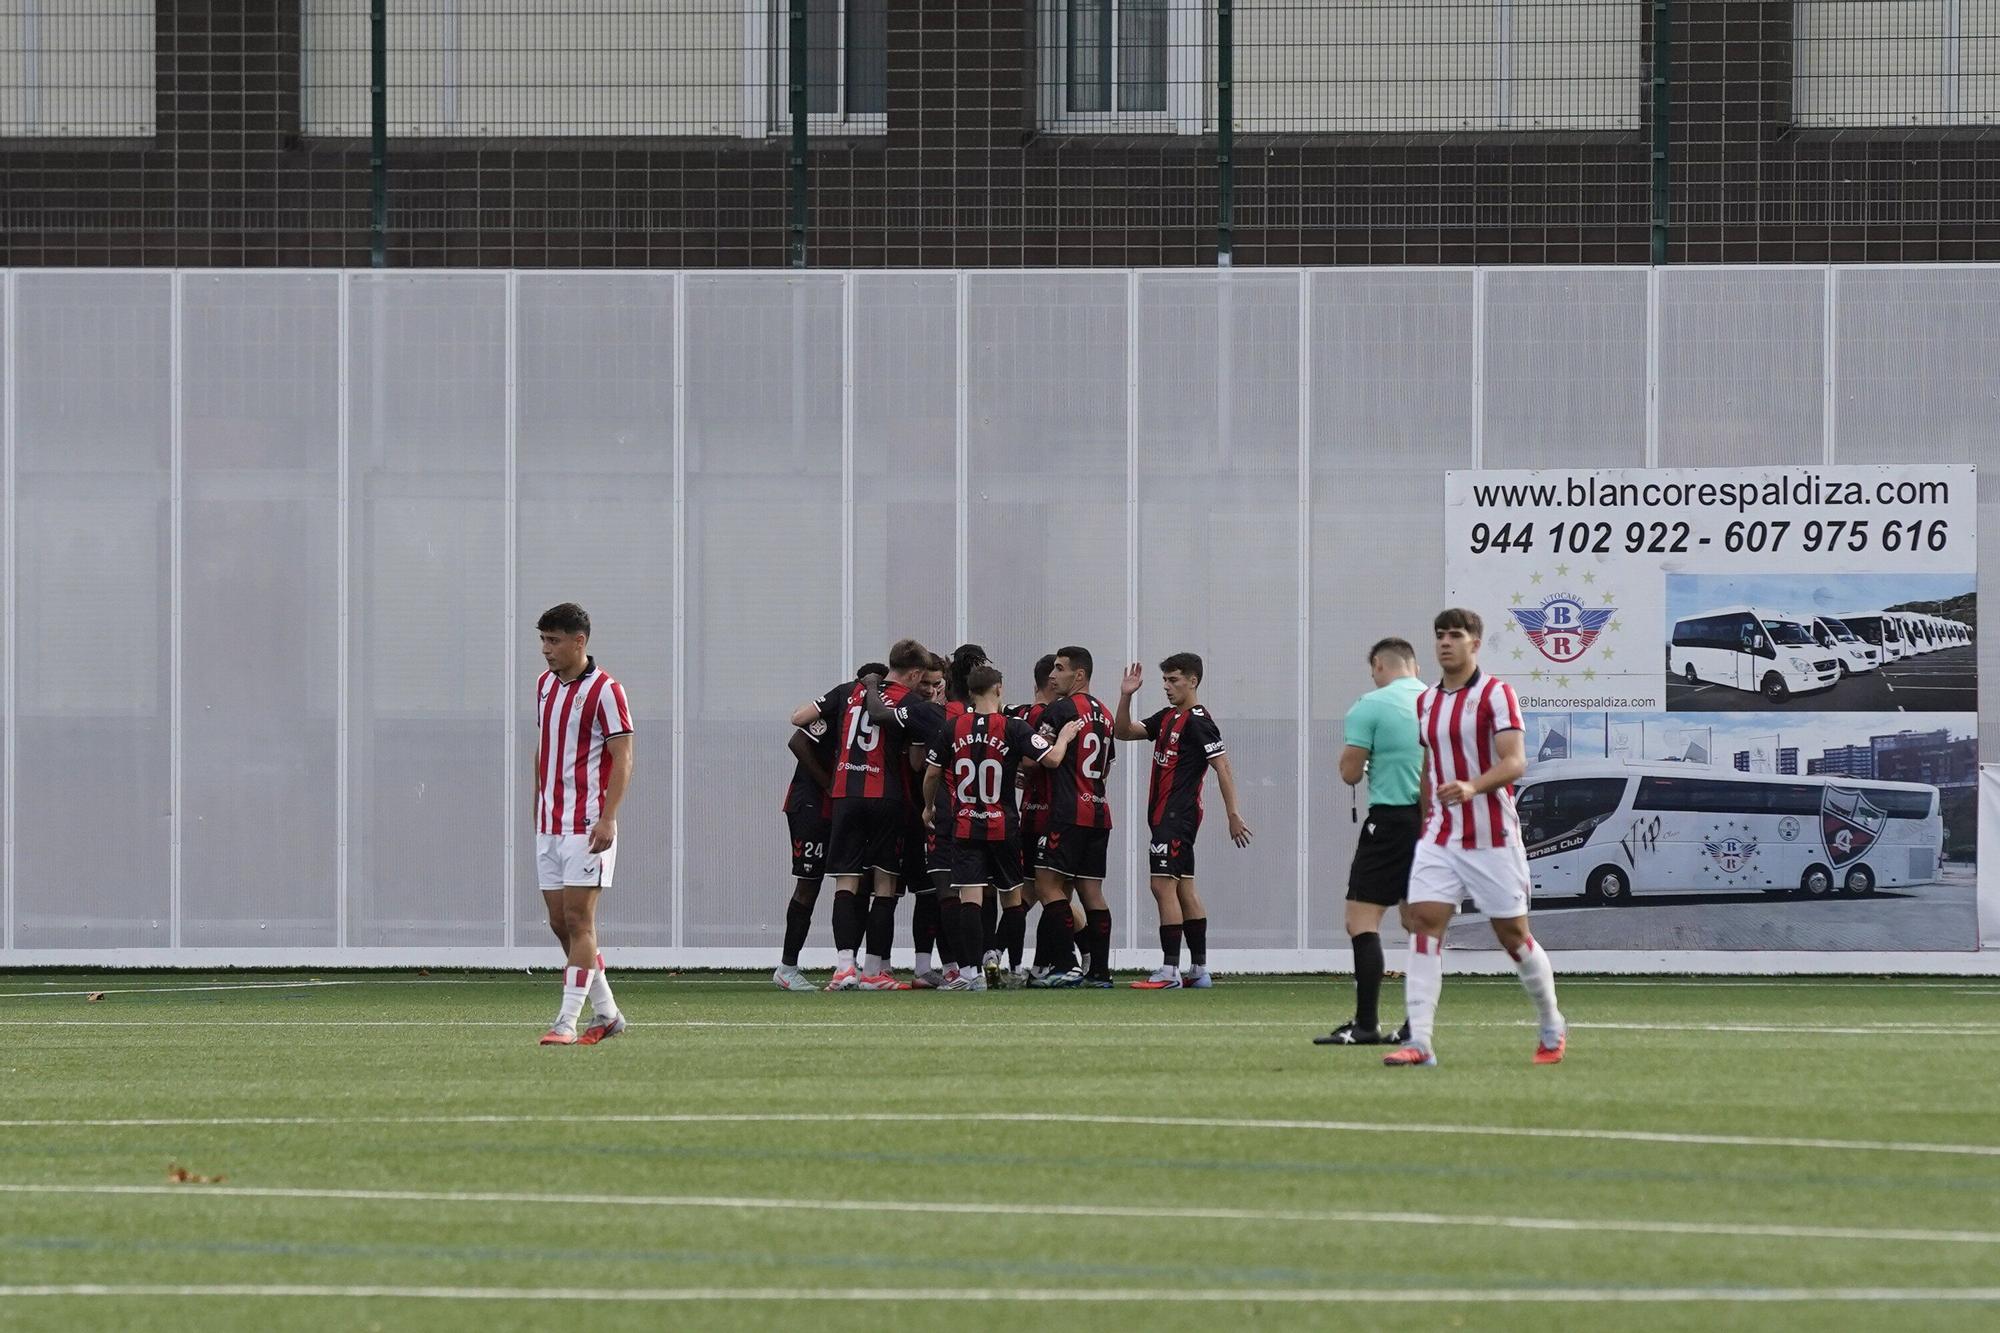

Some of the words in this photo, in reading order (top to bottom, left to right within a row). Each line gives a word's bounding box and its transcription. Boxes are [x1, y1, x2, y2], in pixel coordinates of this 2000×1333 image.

[1473, 475, 1949, 513] www.blancorespaldiza.com
[1470, 522, 1534, 553] 944
[1548, 522, 1613, 553] 102
[1624, 521, 1690, 553] 922
[1724, 520, 1791, 552] 607
[1802, 520, 1869, 552] 975
[1882, 519, 1948, 552] 616
[1539, 592, 1586, 607] AUTOCARES
[1553, 606, 1572, 625] B
[1553, 637, 1572, 655] R
[951, 733, 1010, 756] ZABALETA
[955, 757, 1003, 804] 20
[804, 841, 824, 858] 24
[1560, 837, 1584, 849] Club
